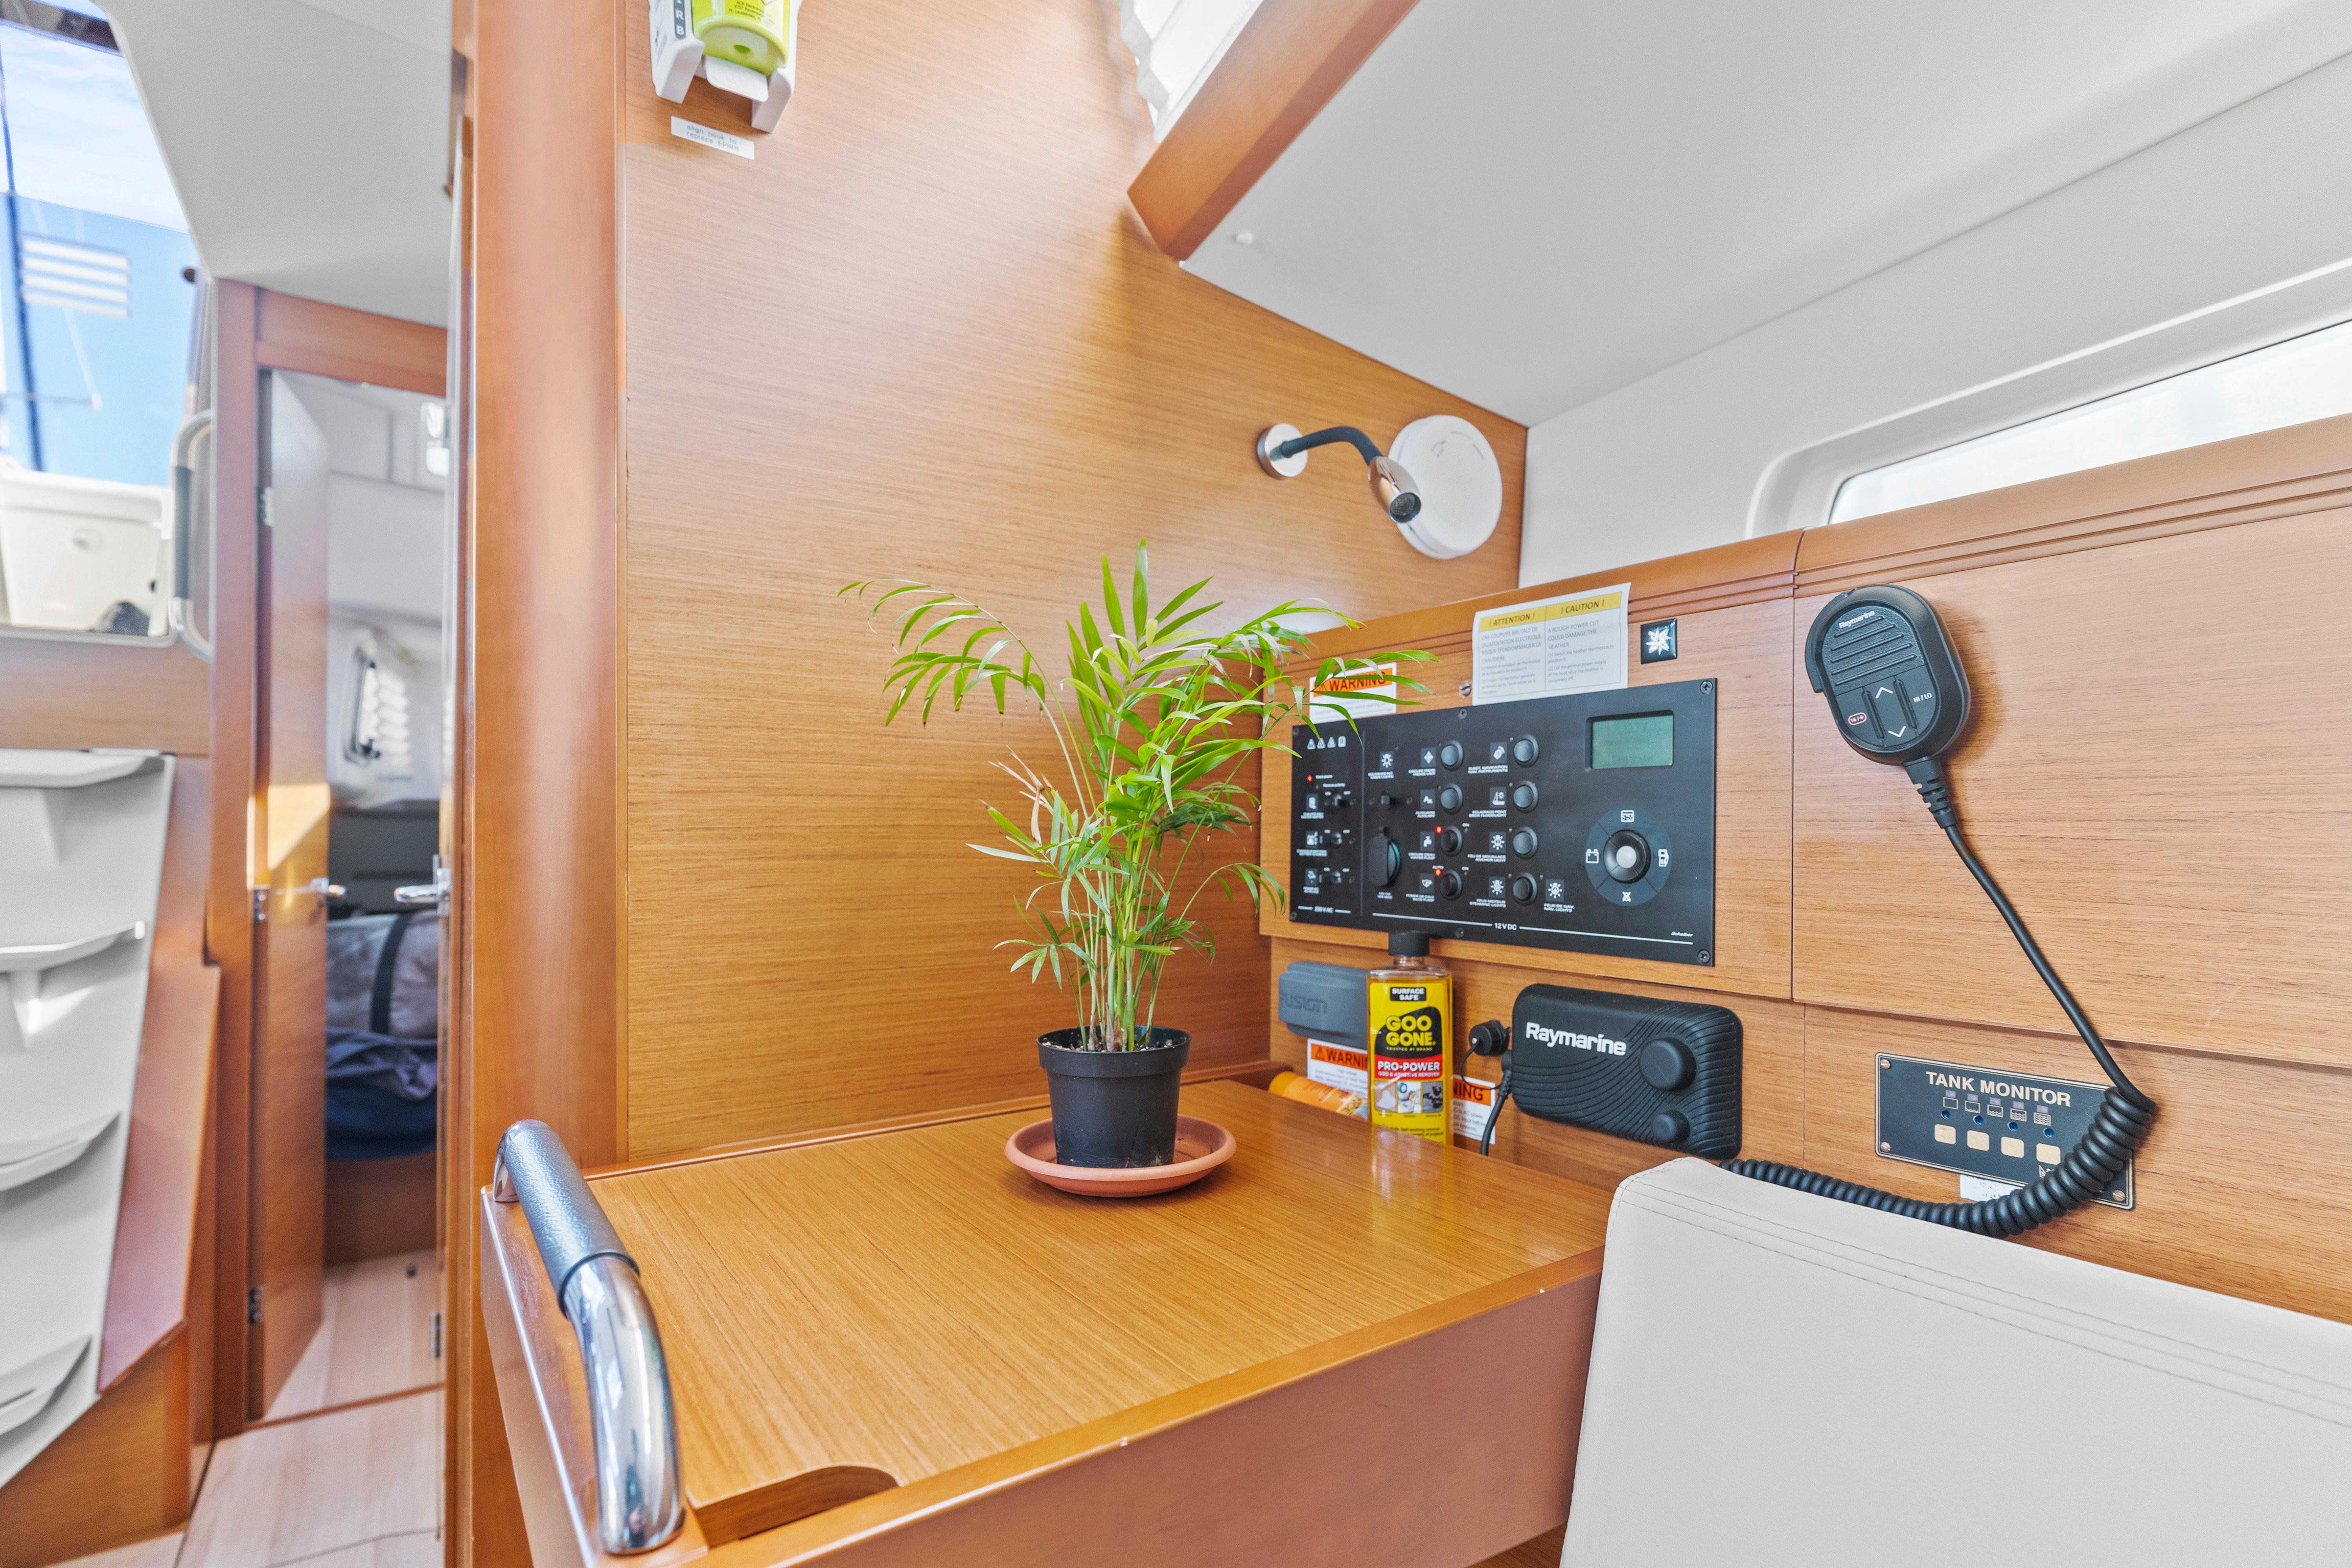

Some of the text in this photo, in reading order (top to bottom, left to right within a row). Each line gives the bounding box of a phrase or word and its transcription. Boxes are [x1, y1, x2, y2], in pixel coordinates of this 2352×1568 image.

[687, 125, 704, 134] align
[686, 131, 713, 144] replace
[1565, 601, 1599, 613] CAUTION
[1493, 613, 1531, 626] ATTENTION
[1570, 622, 1588, 630] POWER
[1838, 610, 1875, 629] Raymarine
[1565, 630, 1587, 639] DAMAGE
[1385, 1015, 1432, 1032] GOO
[1525, 1022, 1626, 1056] Raymarine
[1377, 1060, 1440, 1072] PRO-POWER
[1926, 1071, 2071, 1108] TANK MONITOR
